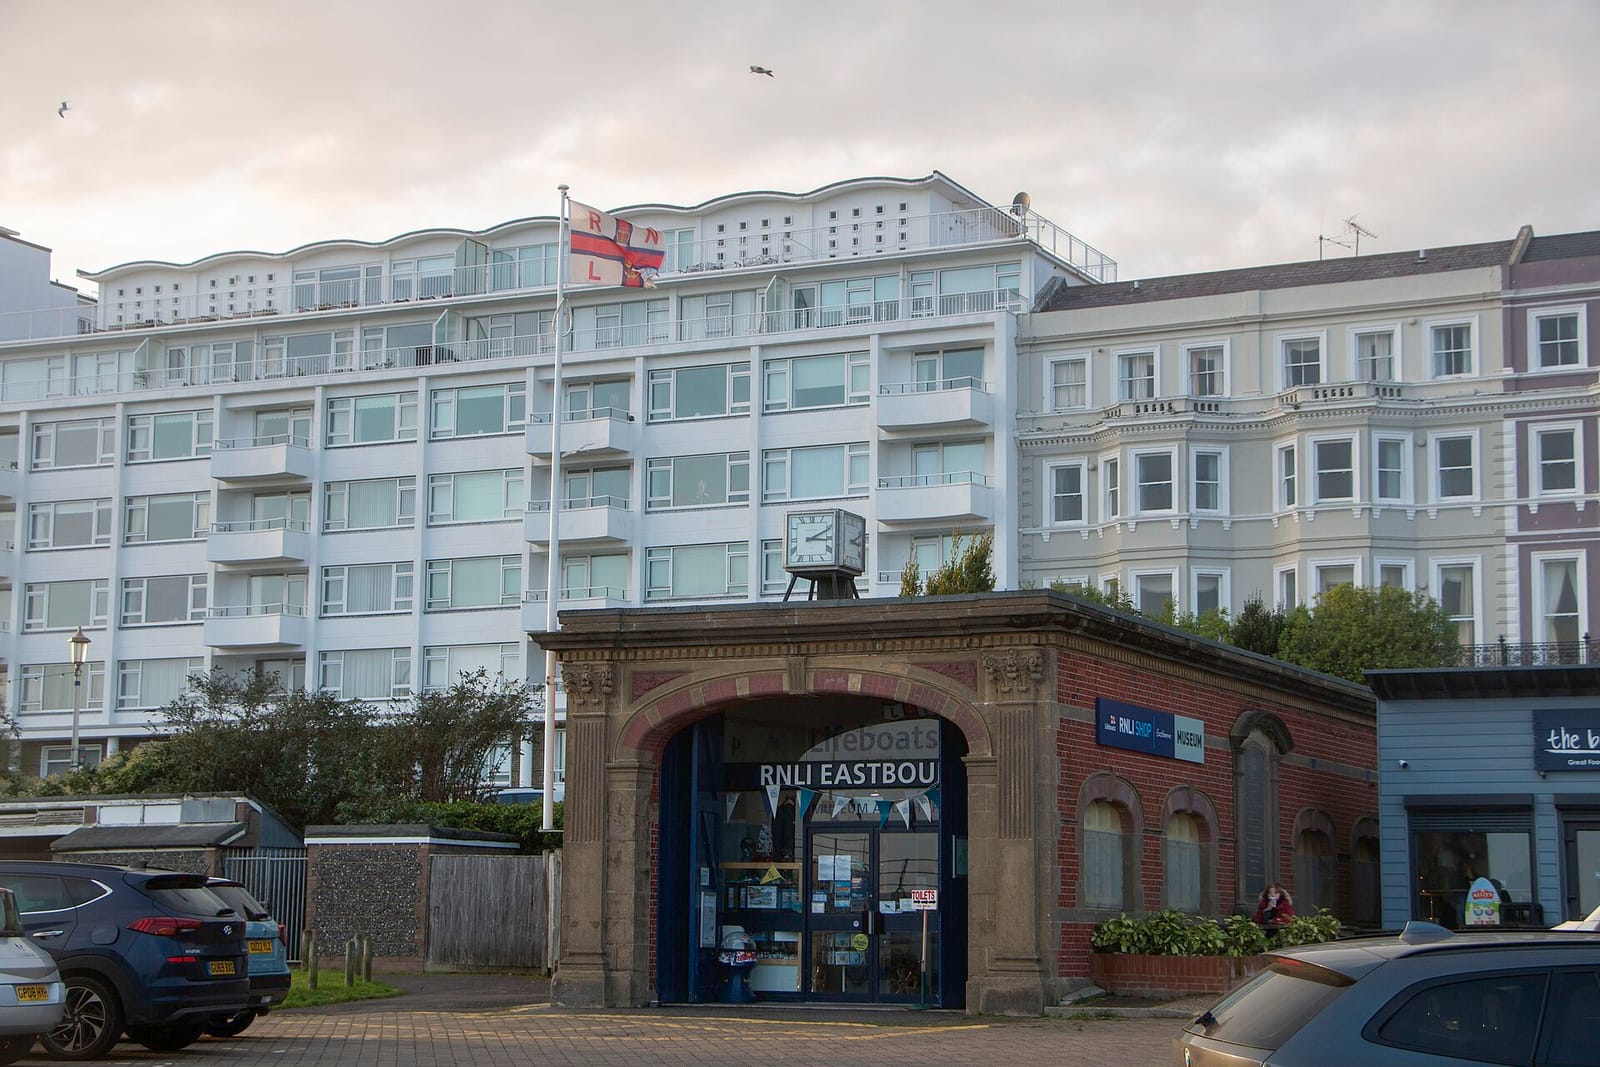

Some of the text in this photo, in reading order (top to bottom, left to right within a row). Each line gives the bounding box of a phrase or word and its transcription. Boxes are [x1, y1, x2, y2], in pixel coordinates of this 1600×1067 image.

[589, 211, 602, 232] R
[588, 260, 601, 281] L
[1119, 717, 1135, 735] RNLI
[1136, 720, 1152, 738] SHOP
[1546, 726, 1581, 750] the
[1176, 729, 1202, 749] MUSEUM
[760, 761, 939, 785] RNLI EASTBOU
[912, 889, 936, 901] TOILETS
